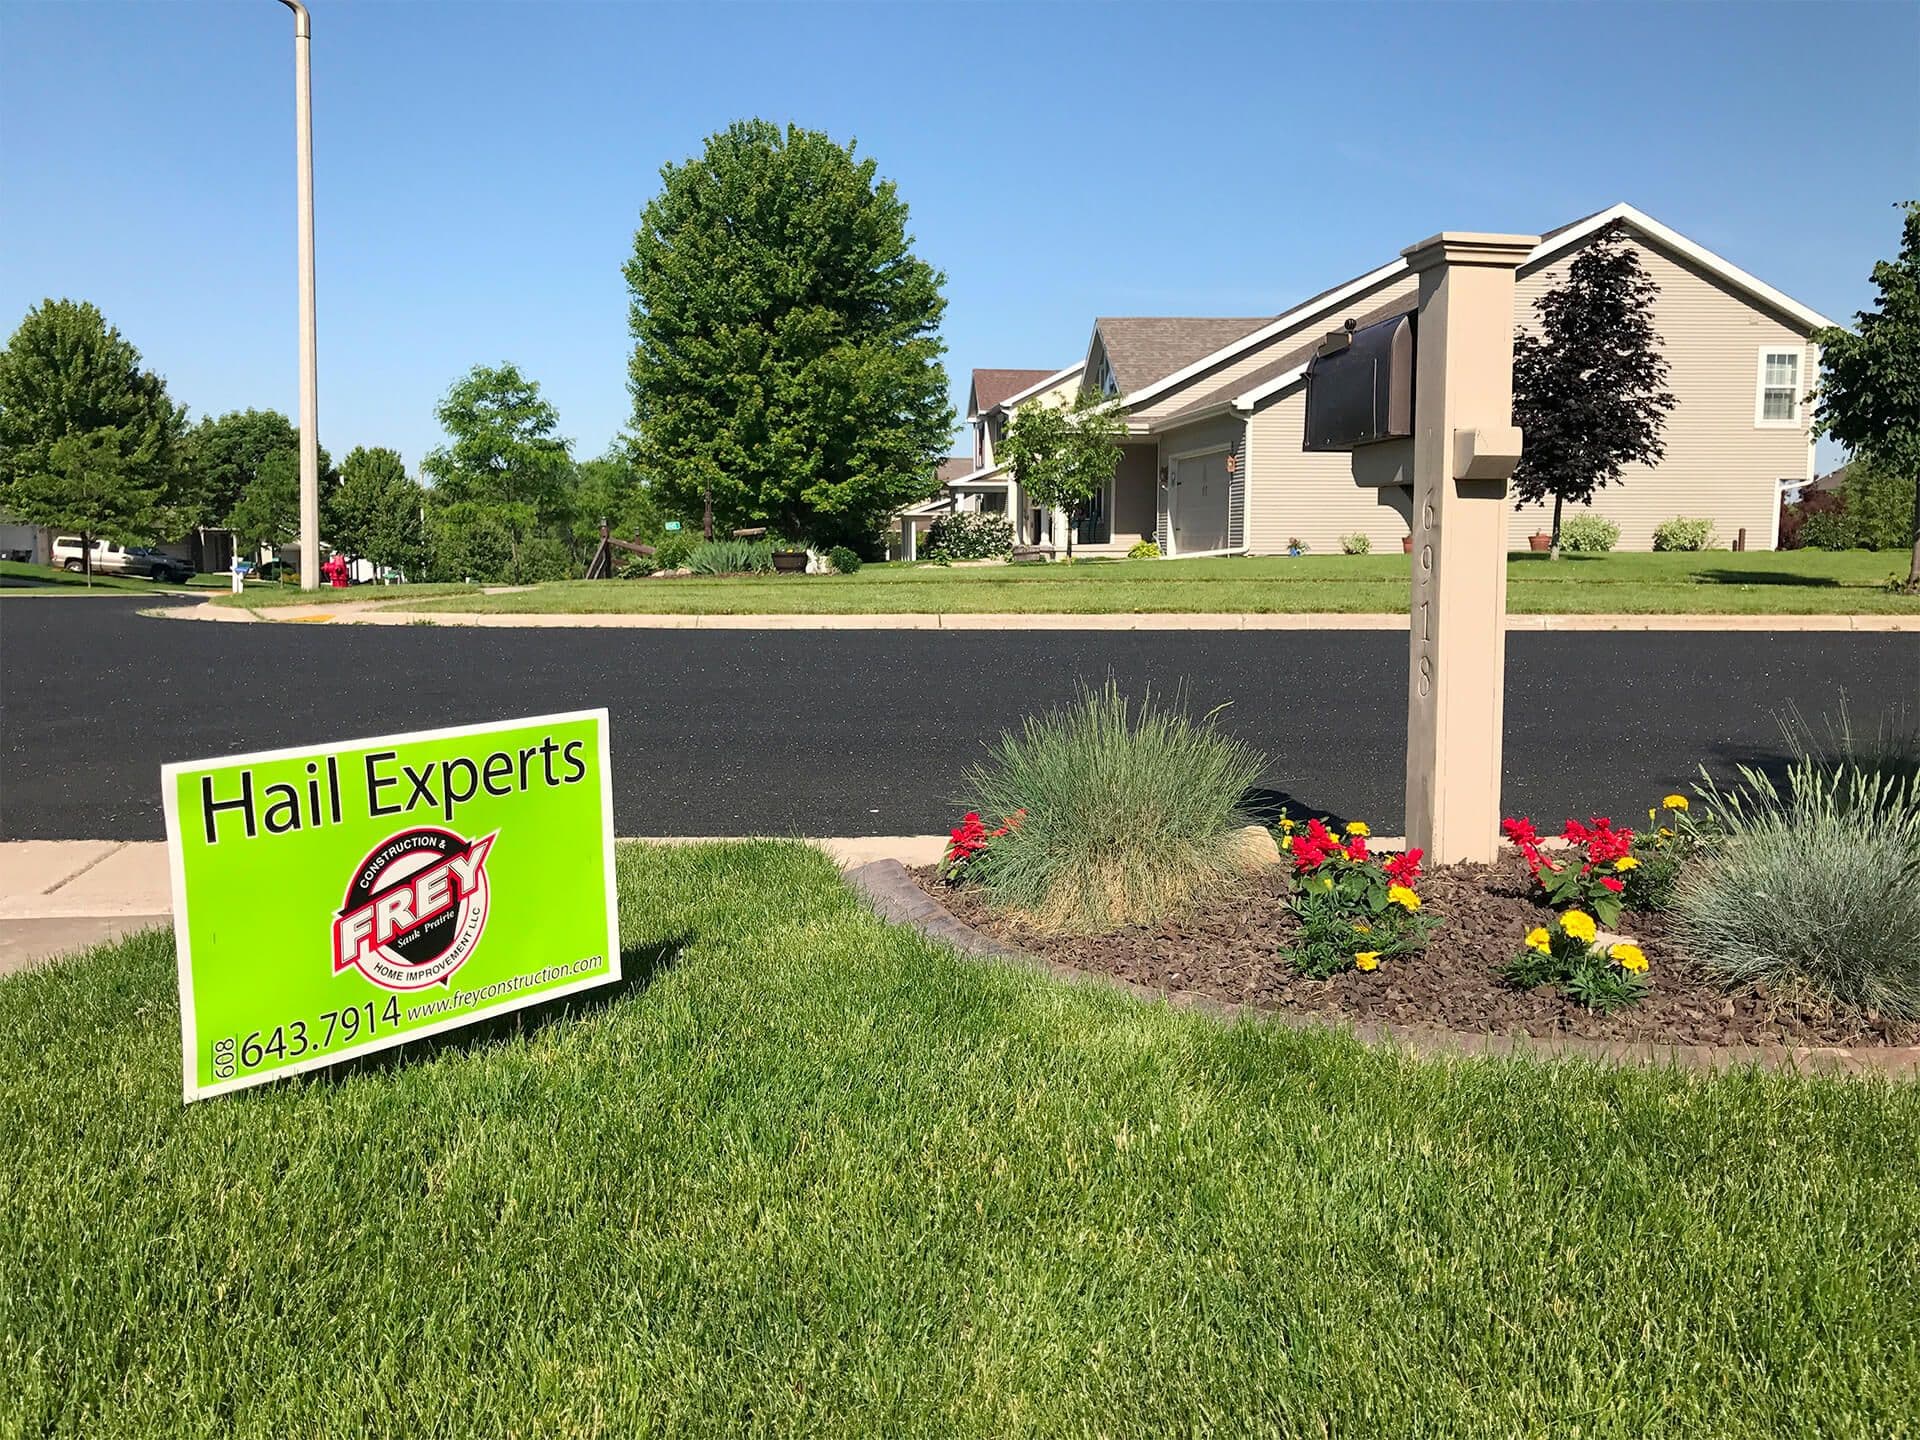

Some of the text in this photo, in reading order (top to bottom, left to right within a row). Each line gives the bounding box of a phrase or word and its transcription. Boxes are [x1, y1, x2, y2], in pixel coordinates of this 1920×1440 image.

[201, 736, 587, 844] Hail Experts
[359, 836, 447, 889] CONSTRUCTION &
[340, 841, 488, 964] FREY
[397, 910, 456, 948] Sauk Prairie
[373, 906, 481, 981] HOME IMPROVEMENT LLC
[240, 955, 603, 1069] 643.7914 www.freyconstruction.com
[215, 1036, 235, 1079] 608
